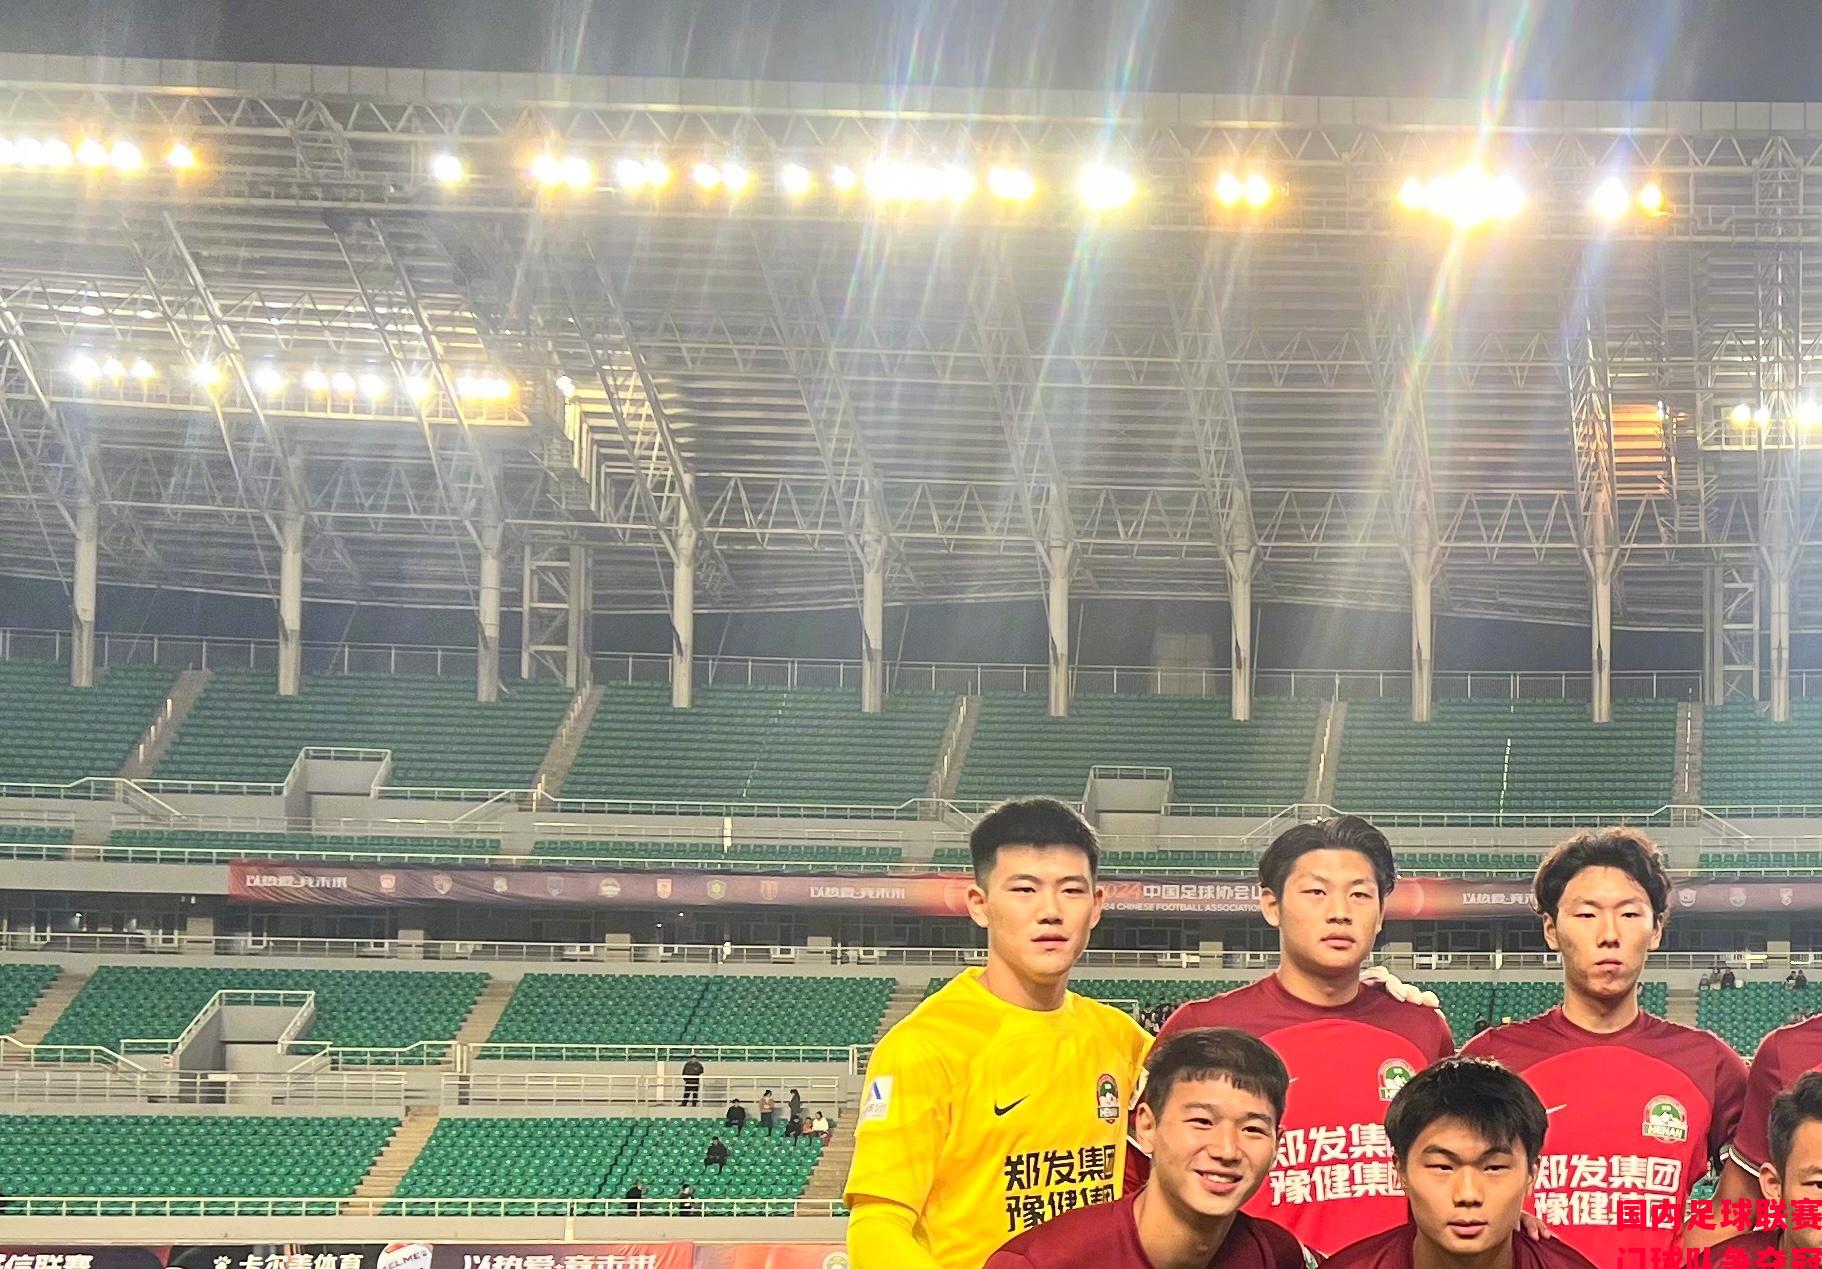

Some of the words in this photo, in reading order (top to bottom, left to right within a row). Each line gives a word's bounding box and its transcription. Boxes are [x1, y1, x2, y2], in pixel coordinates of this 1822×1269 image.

[1156, 903, 1203, 911] FOOTBALL
[1272, 1123, 1396, 1168] 郑发集
